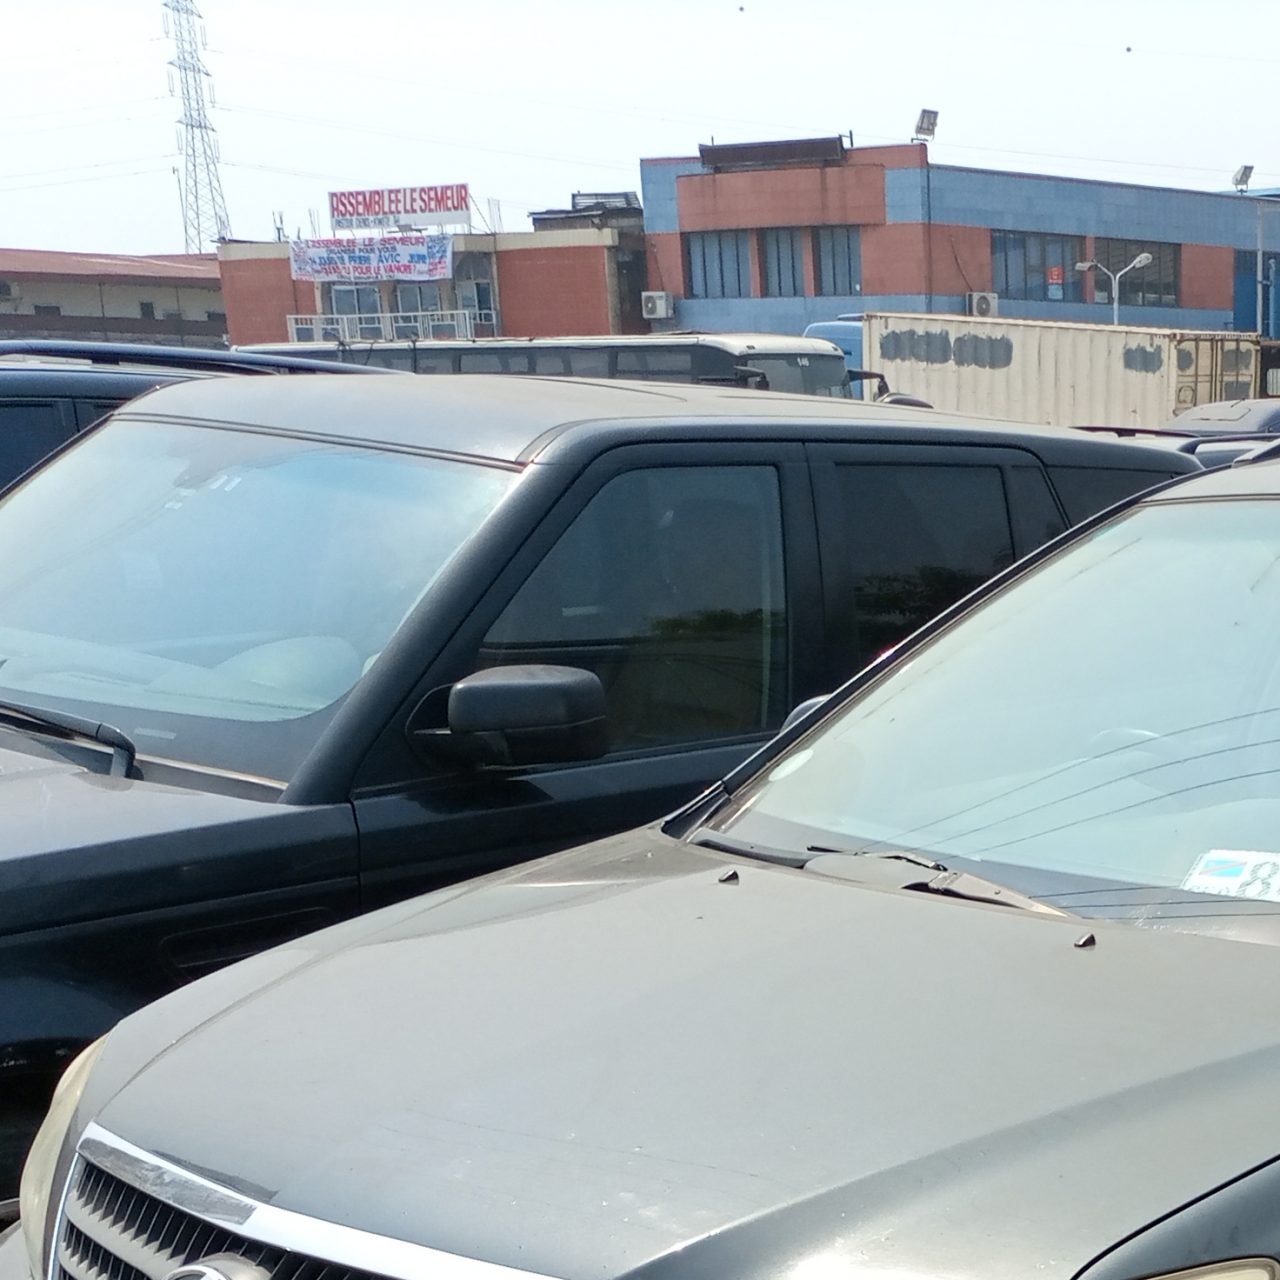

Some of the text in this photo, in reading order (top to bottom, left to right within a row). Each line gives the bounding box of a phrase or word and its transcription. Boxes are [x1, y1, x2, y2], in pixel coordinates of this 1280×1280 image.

[331, 184, 469, 217] ASSEMBLEE LE SEMEUR
